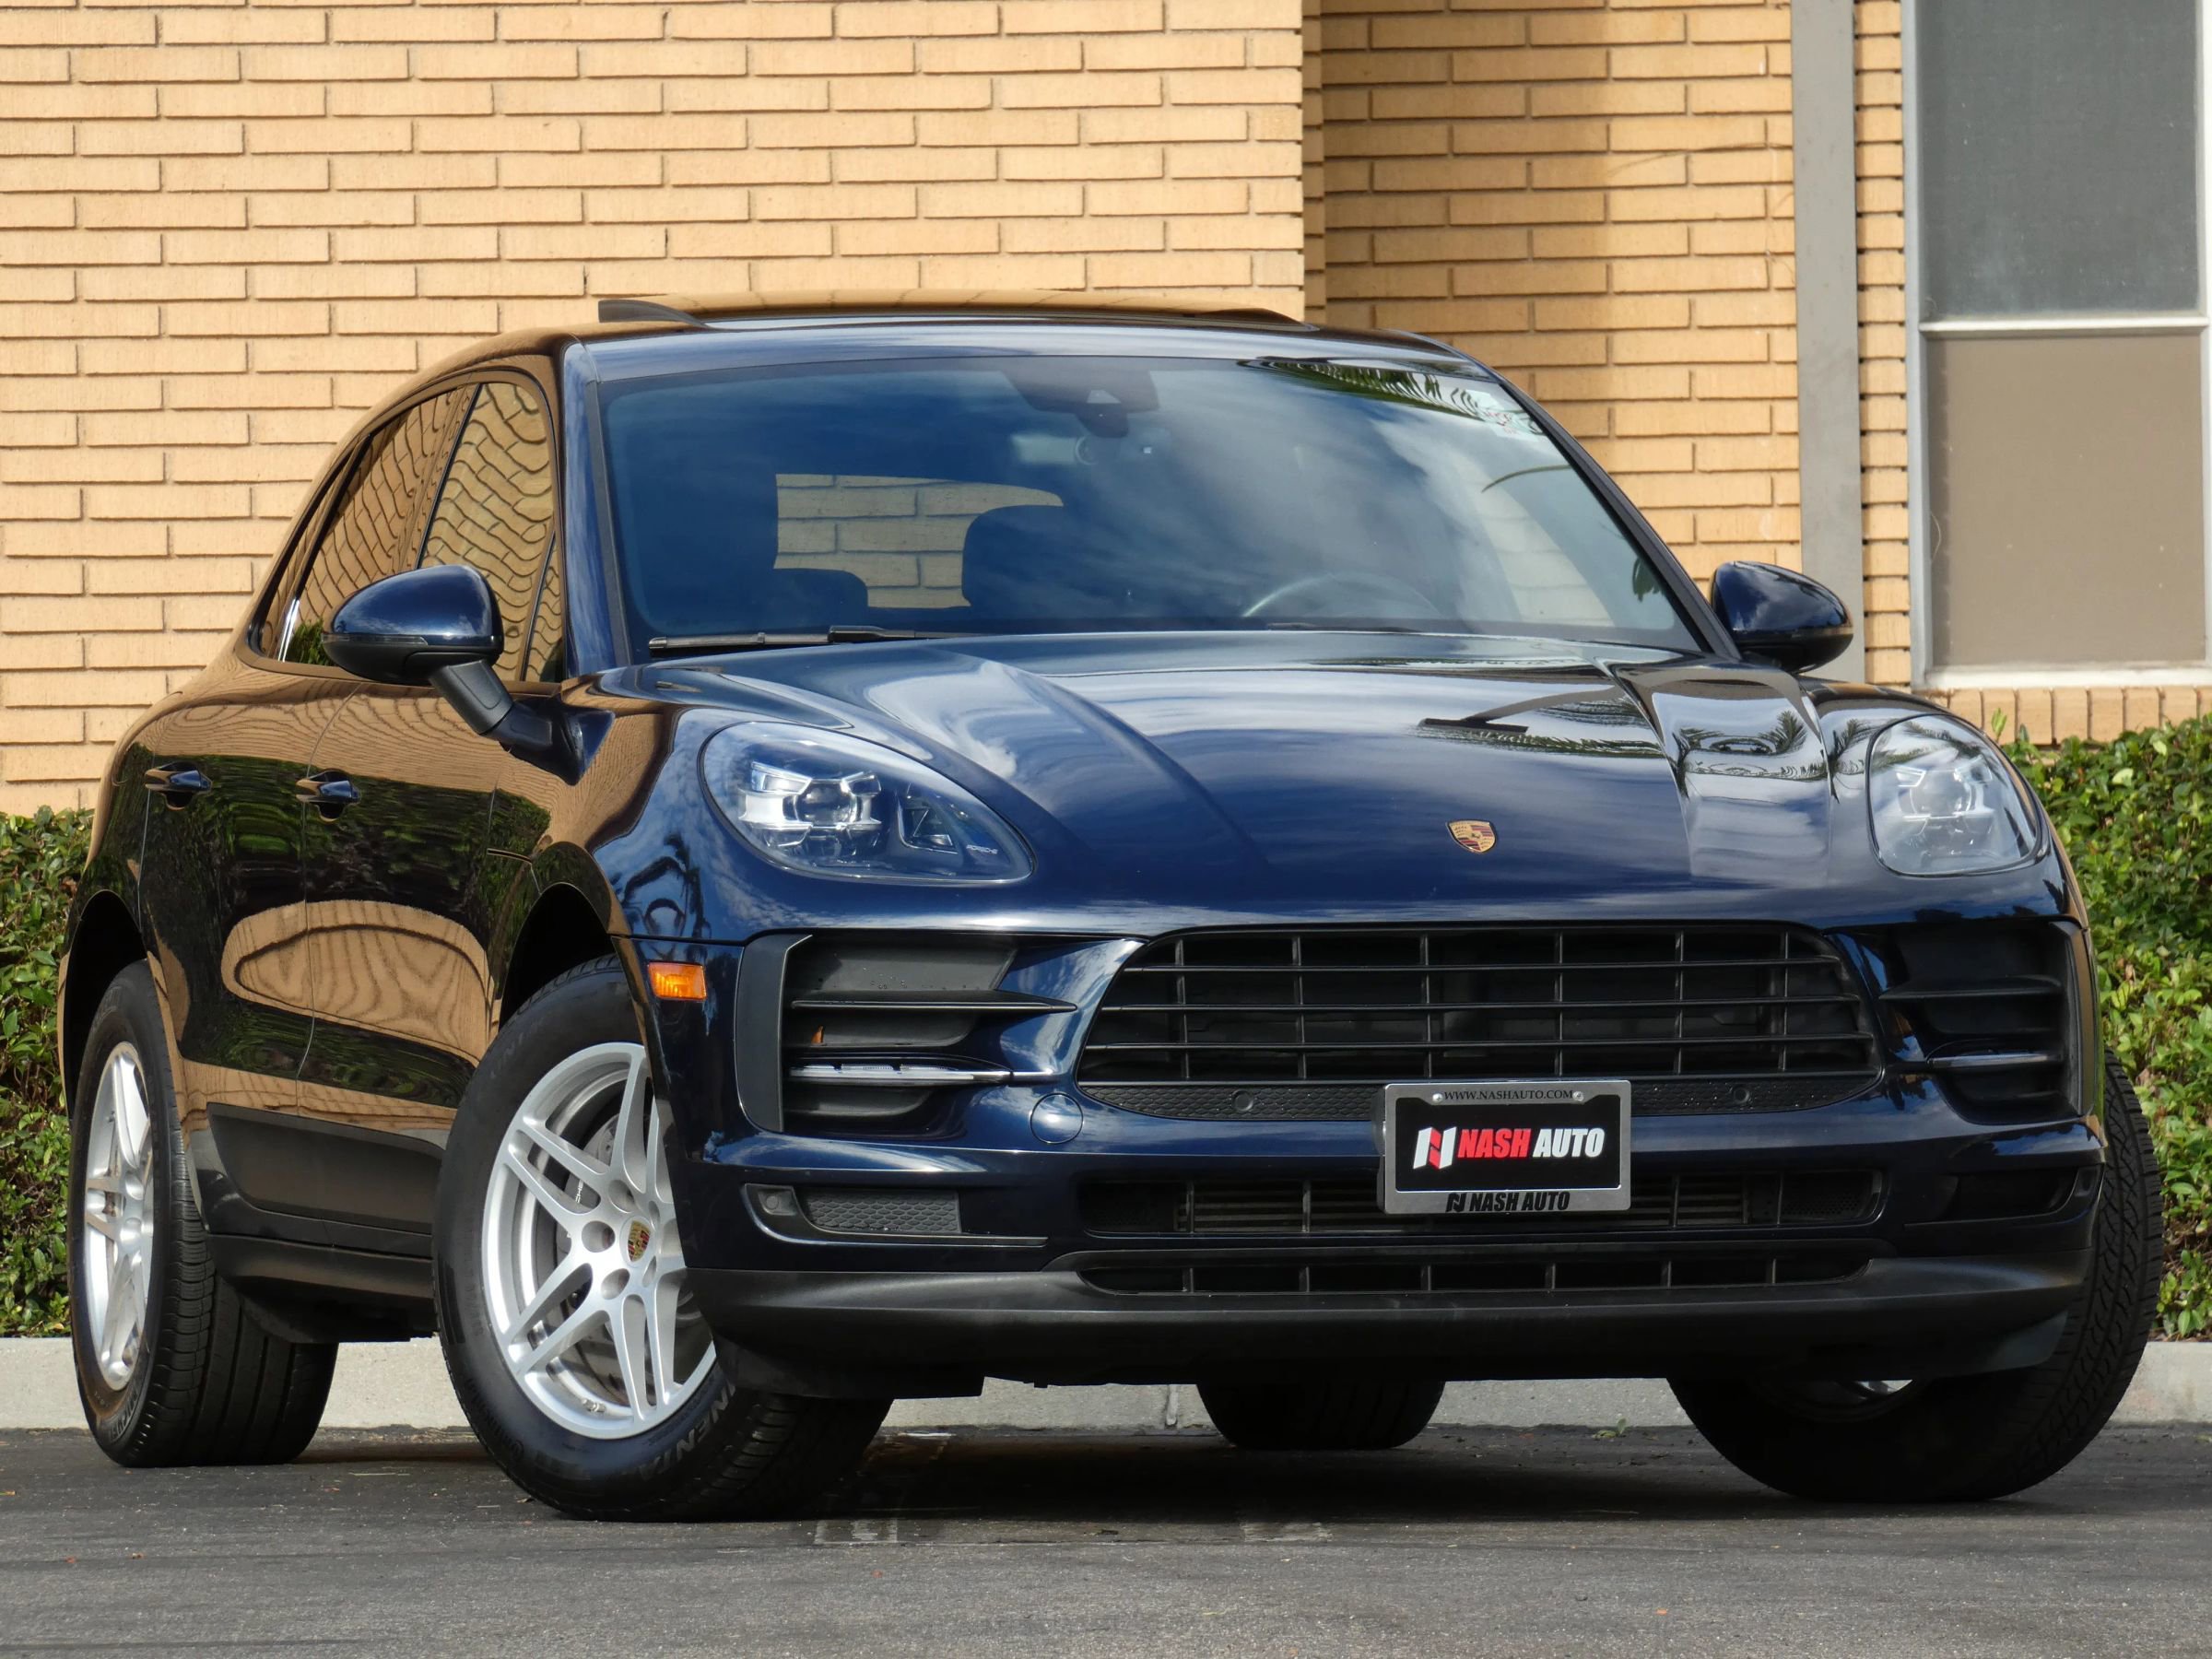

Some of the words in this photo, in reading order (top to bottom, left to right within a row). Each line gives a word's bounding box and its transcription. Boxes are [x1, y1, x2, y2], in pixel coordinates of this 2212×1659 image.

[1444, 1089, 1573, 1100] WWW.NASHAUTO.COM
[1457, 1128, 1532, 1159] NASH
[1533, 1127, 1606, 1159] AUTO
[1469, 1191, 1520, 1212] NASH
[1521, 1190, 1571, 1211] AUTO
